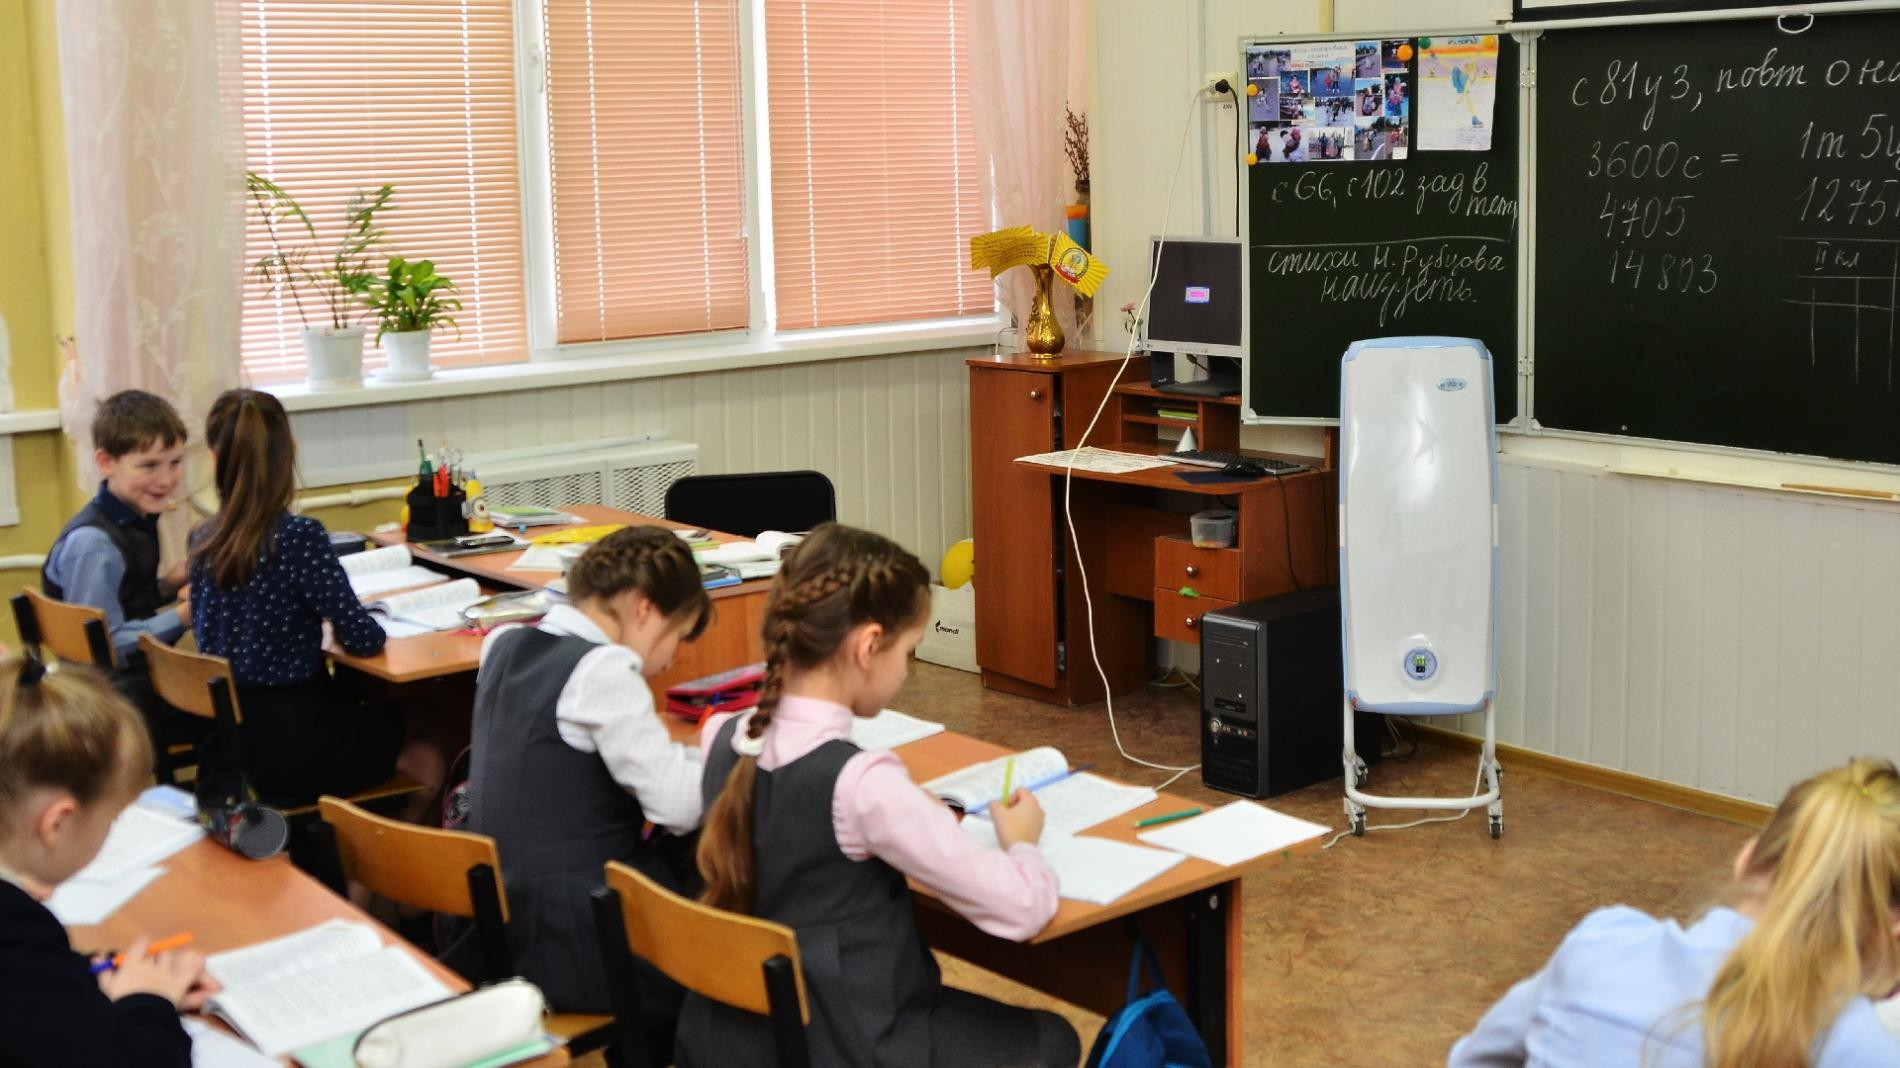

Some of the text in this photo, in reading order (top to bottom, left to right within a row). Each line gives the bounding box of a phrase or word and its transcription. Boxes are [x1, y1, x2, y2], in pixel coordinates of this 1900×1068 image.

[1416, 172, 1465, 216] зад
[1599, 191, 1696, 239] 4705
[1267, 249, 1360, 276] стихи
[1401, 243, 1507, 280] Рубцова
